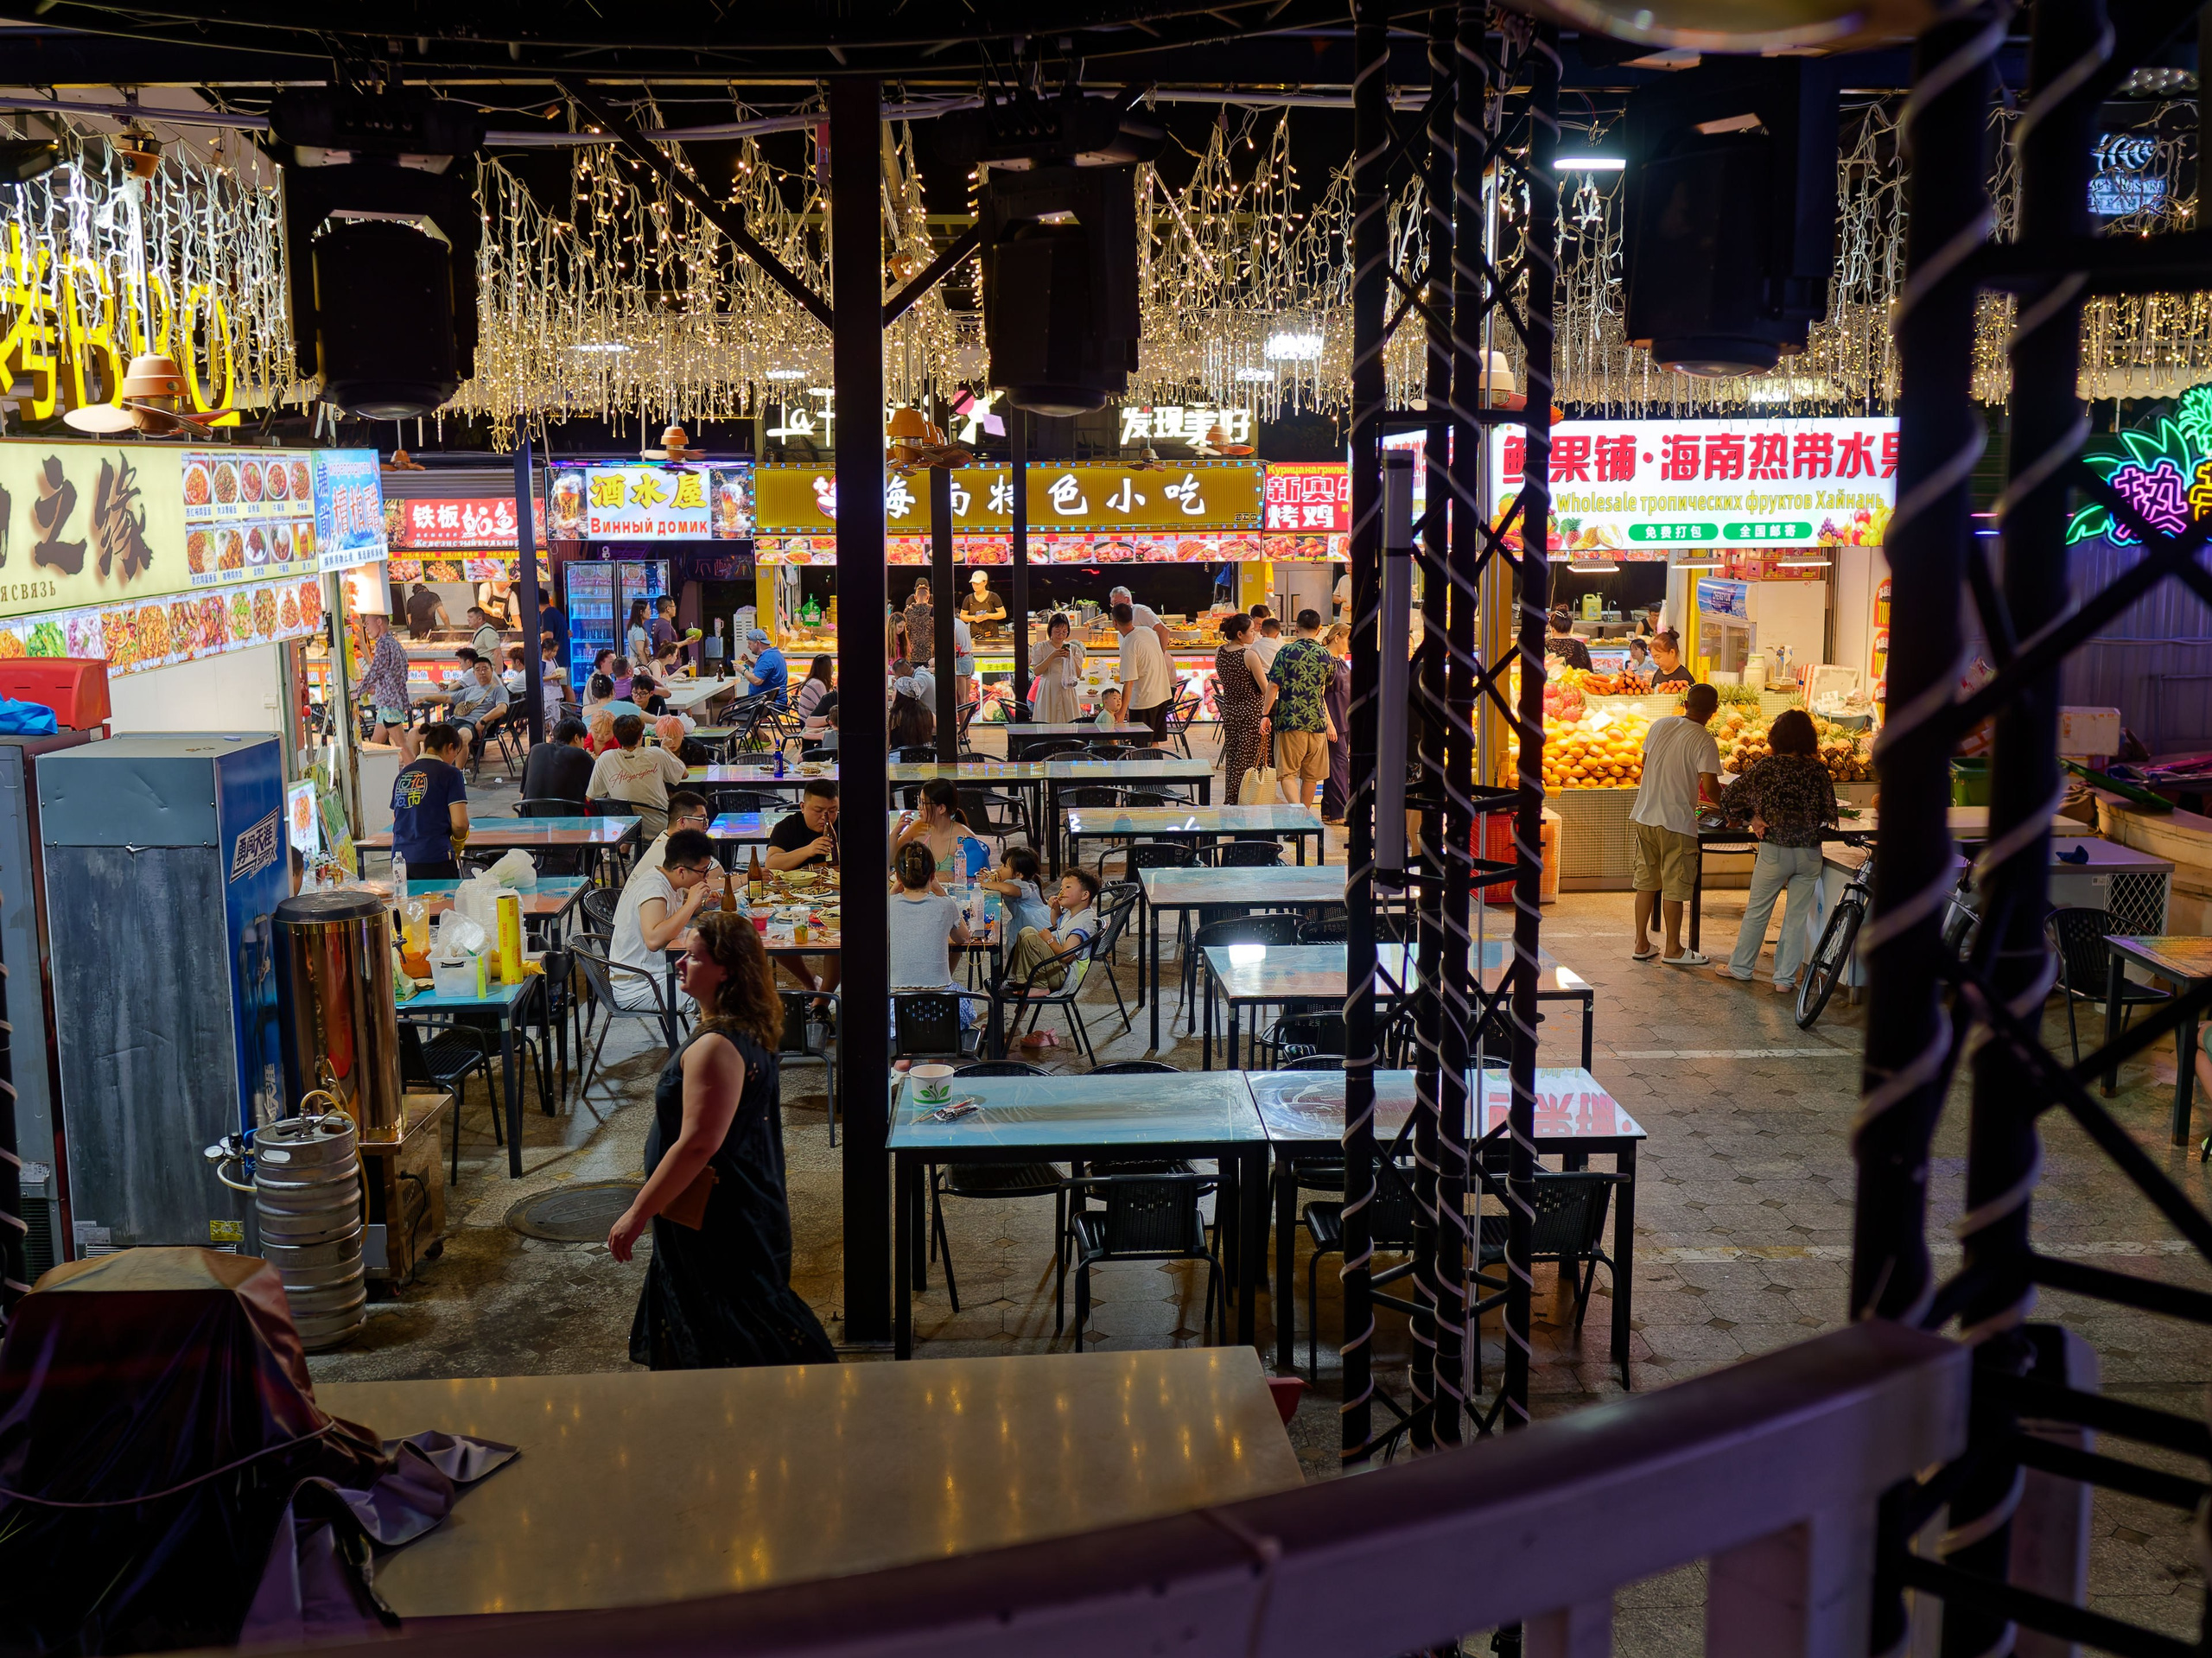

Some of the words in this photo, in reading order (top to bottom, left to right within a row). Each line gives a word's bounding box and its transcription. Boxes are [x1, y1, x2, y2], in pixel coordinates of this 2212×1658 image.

[1121, 403, 1251, 447] 发现美好
[333, 482, 381, 537] 糟粕醋
[590, 473, 708, 510] 酒水屋
[1556, 492, 1637, 512] Wholesale
[1639, 493, 1743, 516] тропических
[1745, 490, 1812, 515] фруктов
[1815, 489, 1885, 511] Хайнань
[0, 449, 153, 585] 之缘
[412, 501, 518, 538] 铁板鱿鱼
[590, 517, 653, 535] Винный
[658, 522, 708, 536] домик
[1267, 504, 1334, 529] 烤鸡
[1645, 524, 1702, 539] 免费打包
[1739, 524, 1796, 538] 全国邮寄
[236, 823, 273, 867] 勇闯天涯
